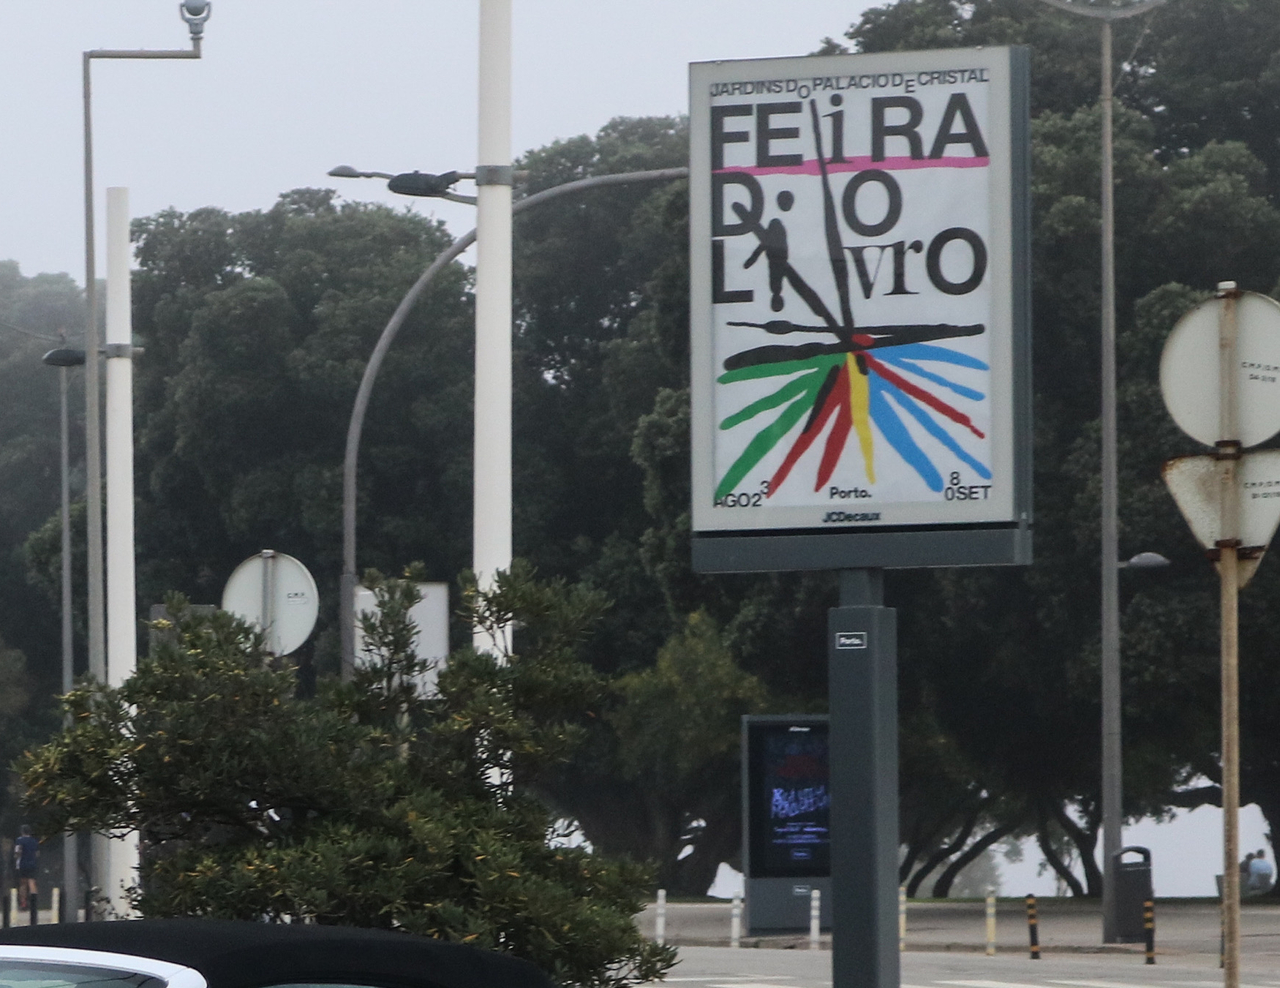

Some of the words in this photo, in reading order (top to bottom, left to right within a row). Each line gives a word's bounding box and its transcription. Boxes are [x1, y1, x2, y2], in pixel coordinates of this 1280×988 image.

[710, 79, 783, 97] JARDINS
[918, 68, 990, 86] CRISTAL
[823, 511, 882, 523] JCDecaux
